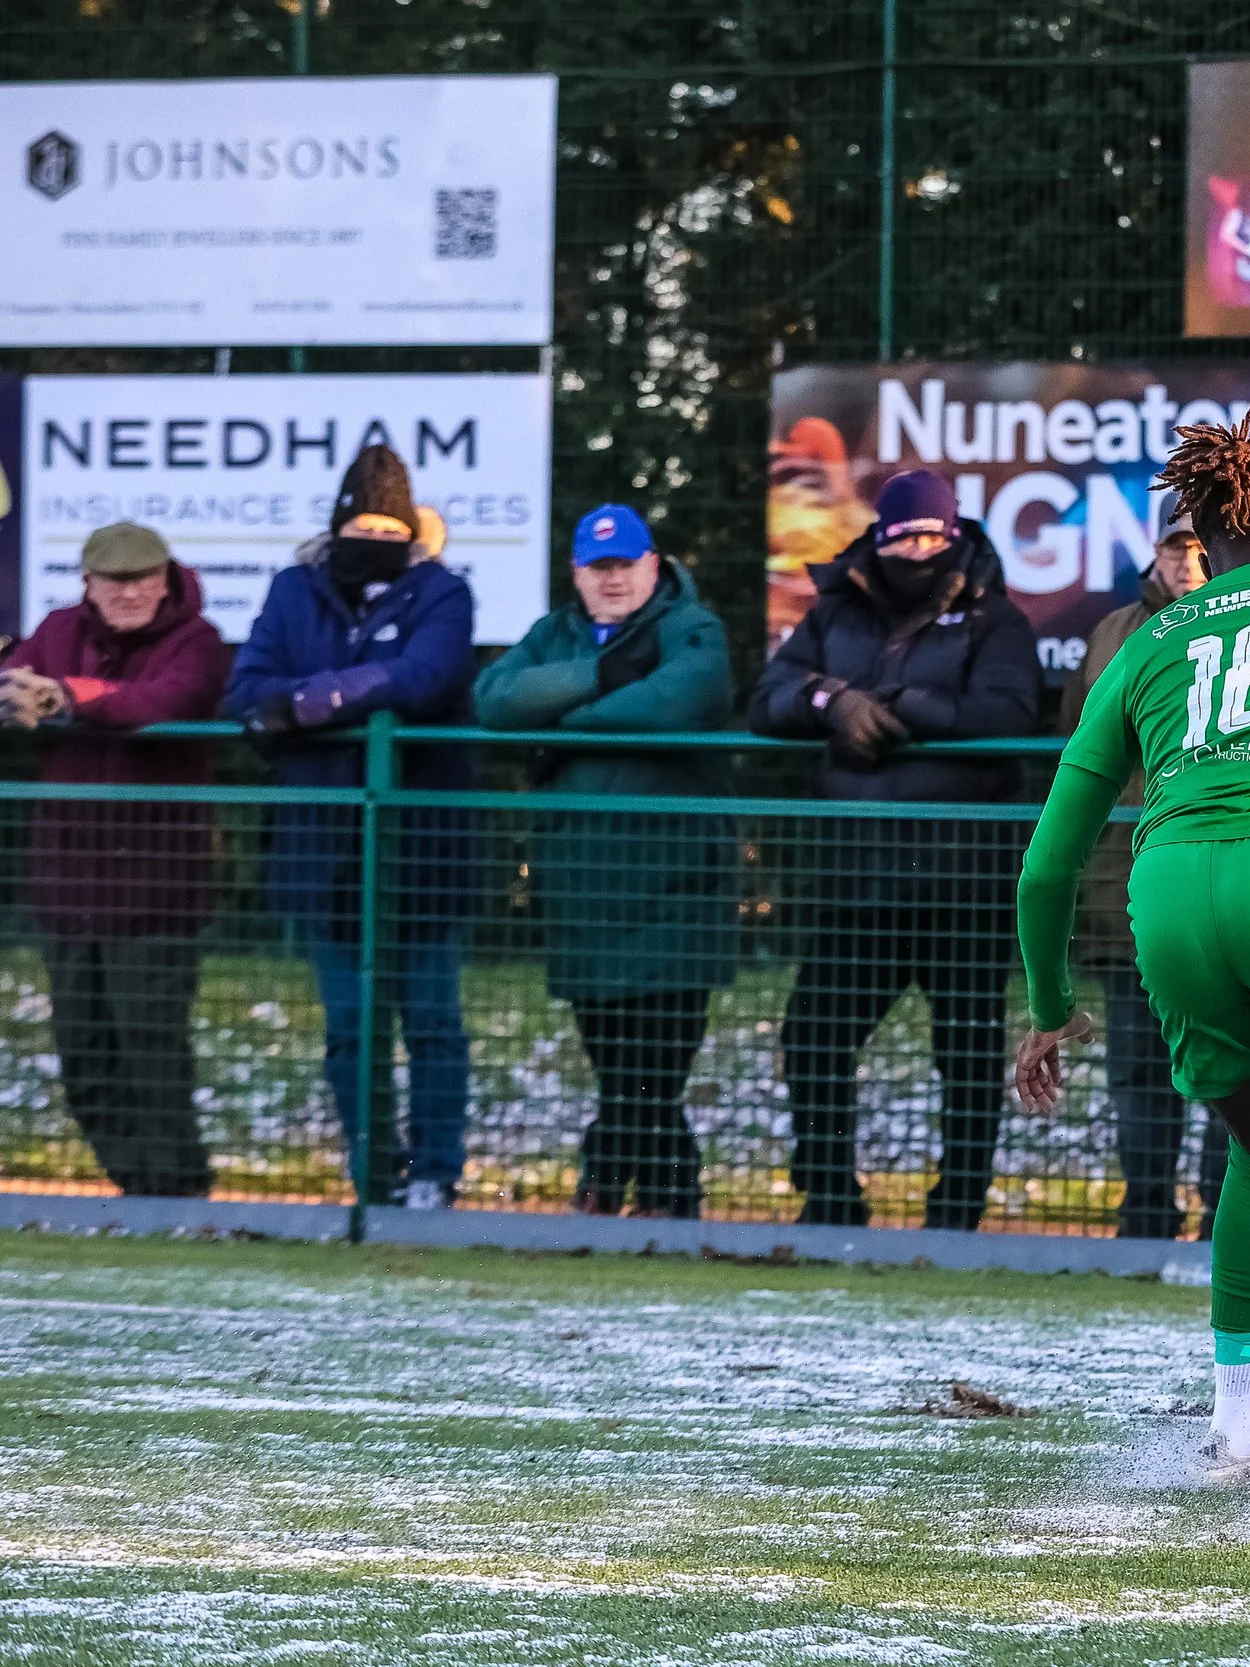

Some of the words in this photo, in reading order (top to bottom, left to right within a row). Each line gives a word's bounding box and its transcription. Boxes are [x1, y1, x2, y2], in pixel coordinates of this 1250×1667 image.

[104, 135, 401, 189] JOHNSONS
[42, 417, 477, 468] NEEDHAM
[40, 493, 295, 526] INSURANCE
[306, 493, 532, 527] SCES
